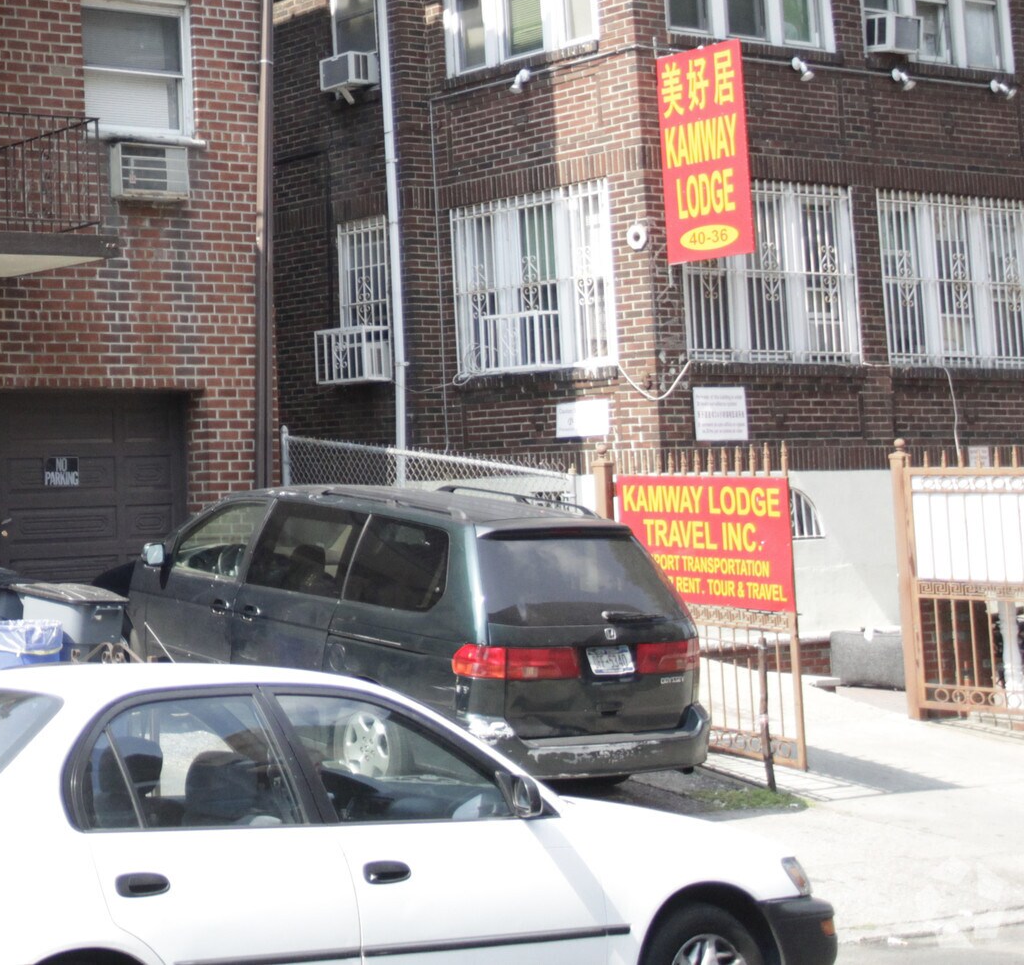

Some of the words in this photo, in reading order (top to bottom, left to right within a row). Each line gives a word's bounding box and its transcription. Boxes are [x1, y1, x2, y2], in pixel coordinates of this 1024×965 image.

[661, 49, 735, 119] 美好居
[664, 113, 737, 169] KAMWAY
[676, 168, 736, 220] LODGE
[689, 229, 728, 245] 40-36
[56, 457, 67, 471] NO
[44, 471, 79, 486] PARKING
[622, 485, 703, 514] KAMWAY
[708, 486, 781, 517] LODGE
[643, 519, 718, 550] TRAVEL
[721, 522, 763, 552] INC.
[681, 555, 770, 578] TRANSPORTATION
[707, 579, 735, 597] TOUR
[737, 582, 745, 598] &
[746, 582, 788, 602] TRAVEL
